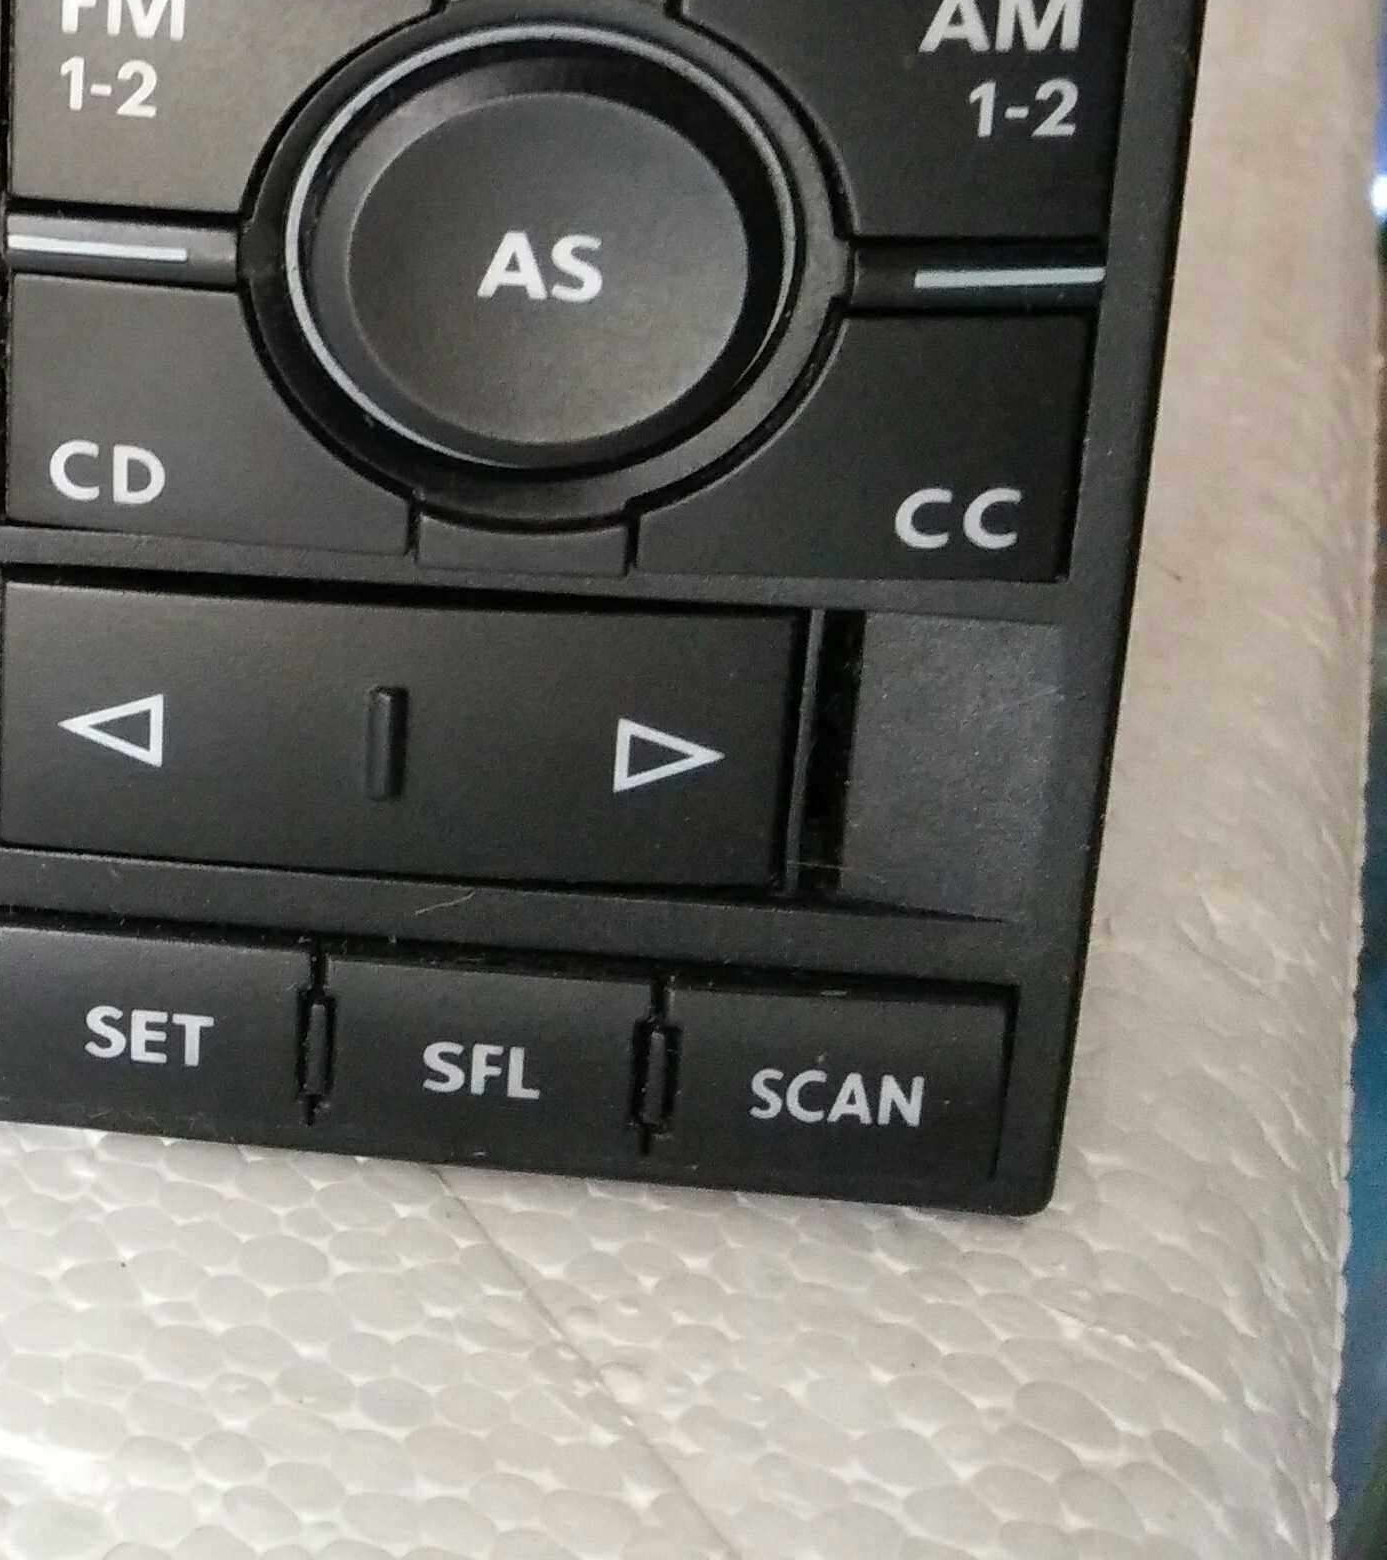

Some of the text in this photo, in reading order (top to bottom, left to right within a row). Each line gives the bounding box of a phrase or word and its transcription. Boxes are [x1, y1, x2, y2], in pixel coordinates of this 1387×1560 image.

[60, 57, 158, 119] 1-2
[968, 77, 1079, 138] 1-2
[477, 231, 604, 303] AS
[49, 439, 166, 505] CD
[894, 487, 1022, 550] CC
[85, 1004, 215, 1067] SET
[422, 1041, 540, 1100] SFL
[750, 1068, 925, 1127] SCAN
